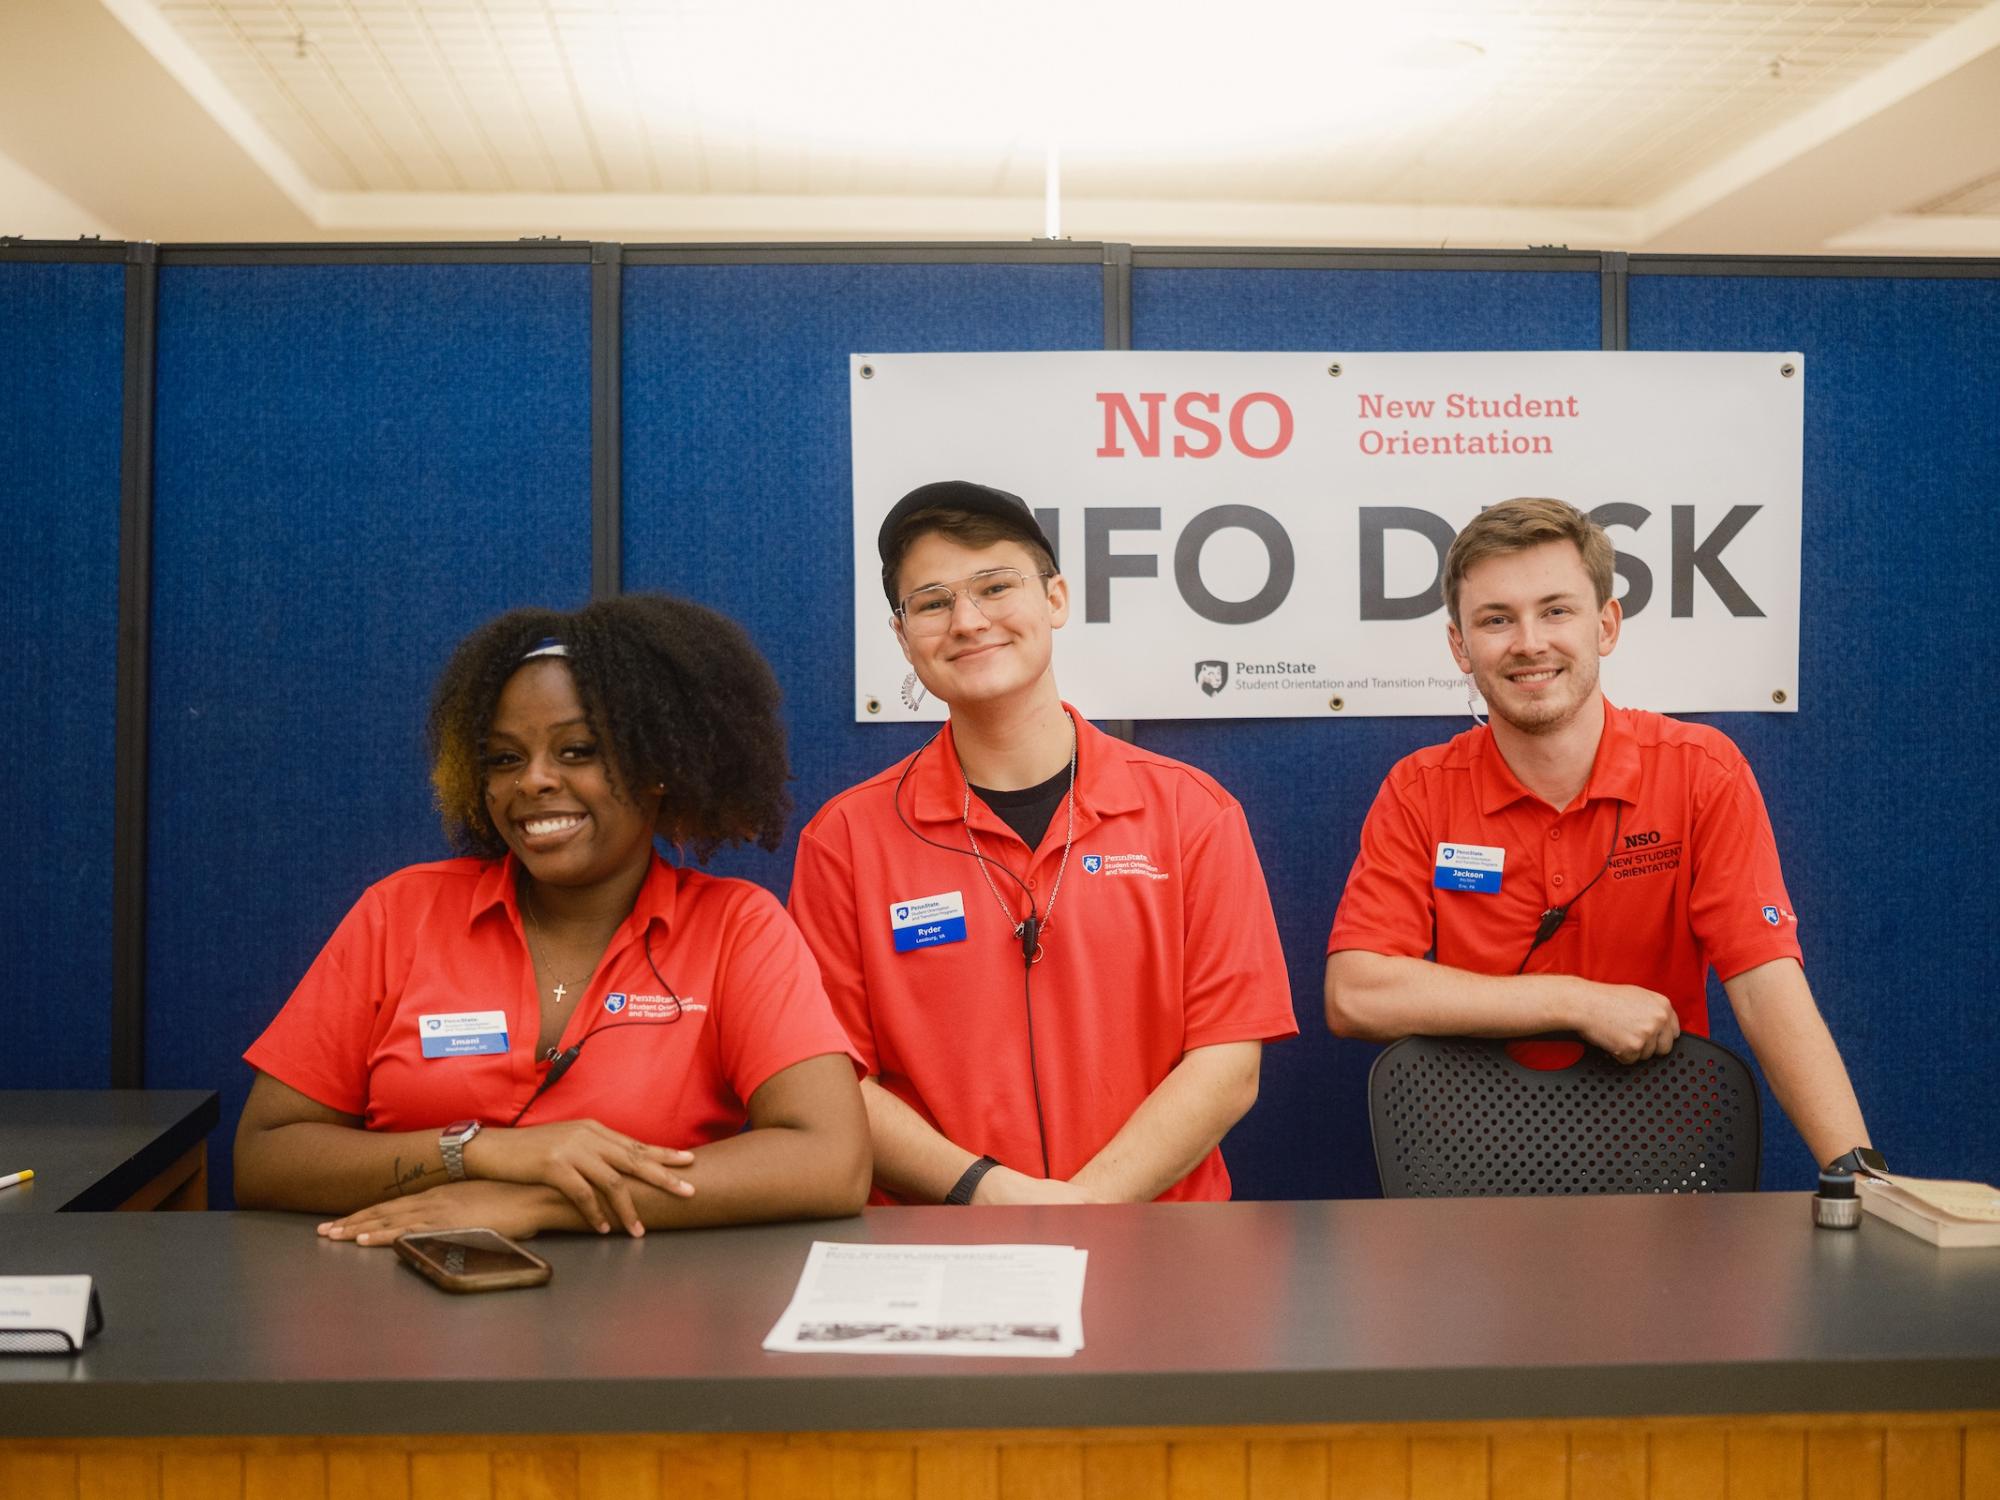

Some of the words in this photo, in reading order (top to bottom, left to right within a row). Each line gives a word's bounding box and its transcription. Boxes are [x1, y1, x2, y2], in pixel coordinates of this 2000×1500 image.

[1358, 394, 1436, 418] New
[1446, 393, 1579, 418] Student
[1096, 391, 1294, 459] NSO
[1358, 429, 1553, 455] Orientation
[1034, 504, 1295, 625] FO
[1359, 502, 1767, 621] DSK
[1236, 661, 1316, 674] PennState
[1236, 679, 1279, 690] Student
[1281, 678, 1345, 690] Orientation
[1347, 678, 1368, 689] and
[1372, 677, 1425, 689] Transition
[1624, 830, 1660, 848] NSO
[1104, 853, 1148, 862] PennState
[1608, 857, 1632, 868] NEW
[1635, 846, 1682, 864] STUDENT
[1453, 870, 1484, 879] Jackson
[911, 902, 939, 911] PennState
[918, 926, 942, 936] Ryder
[451, 1037, 480, 1046] Imani
